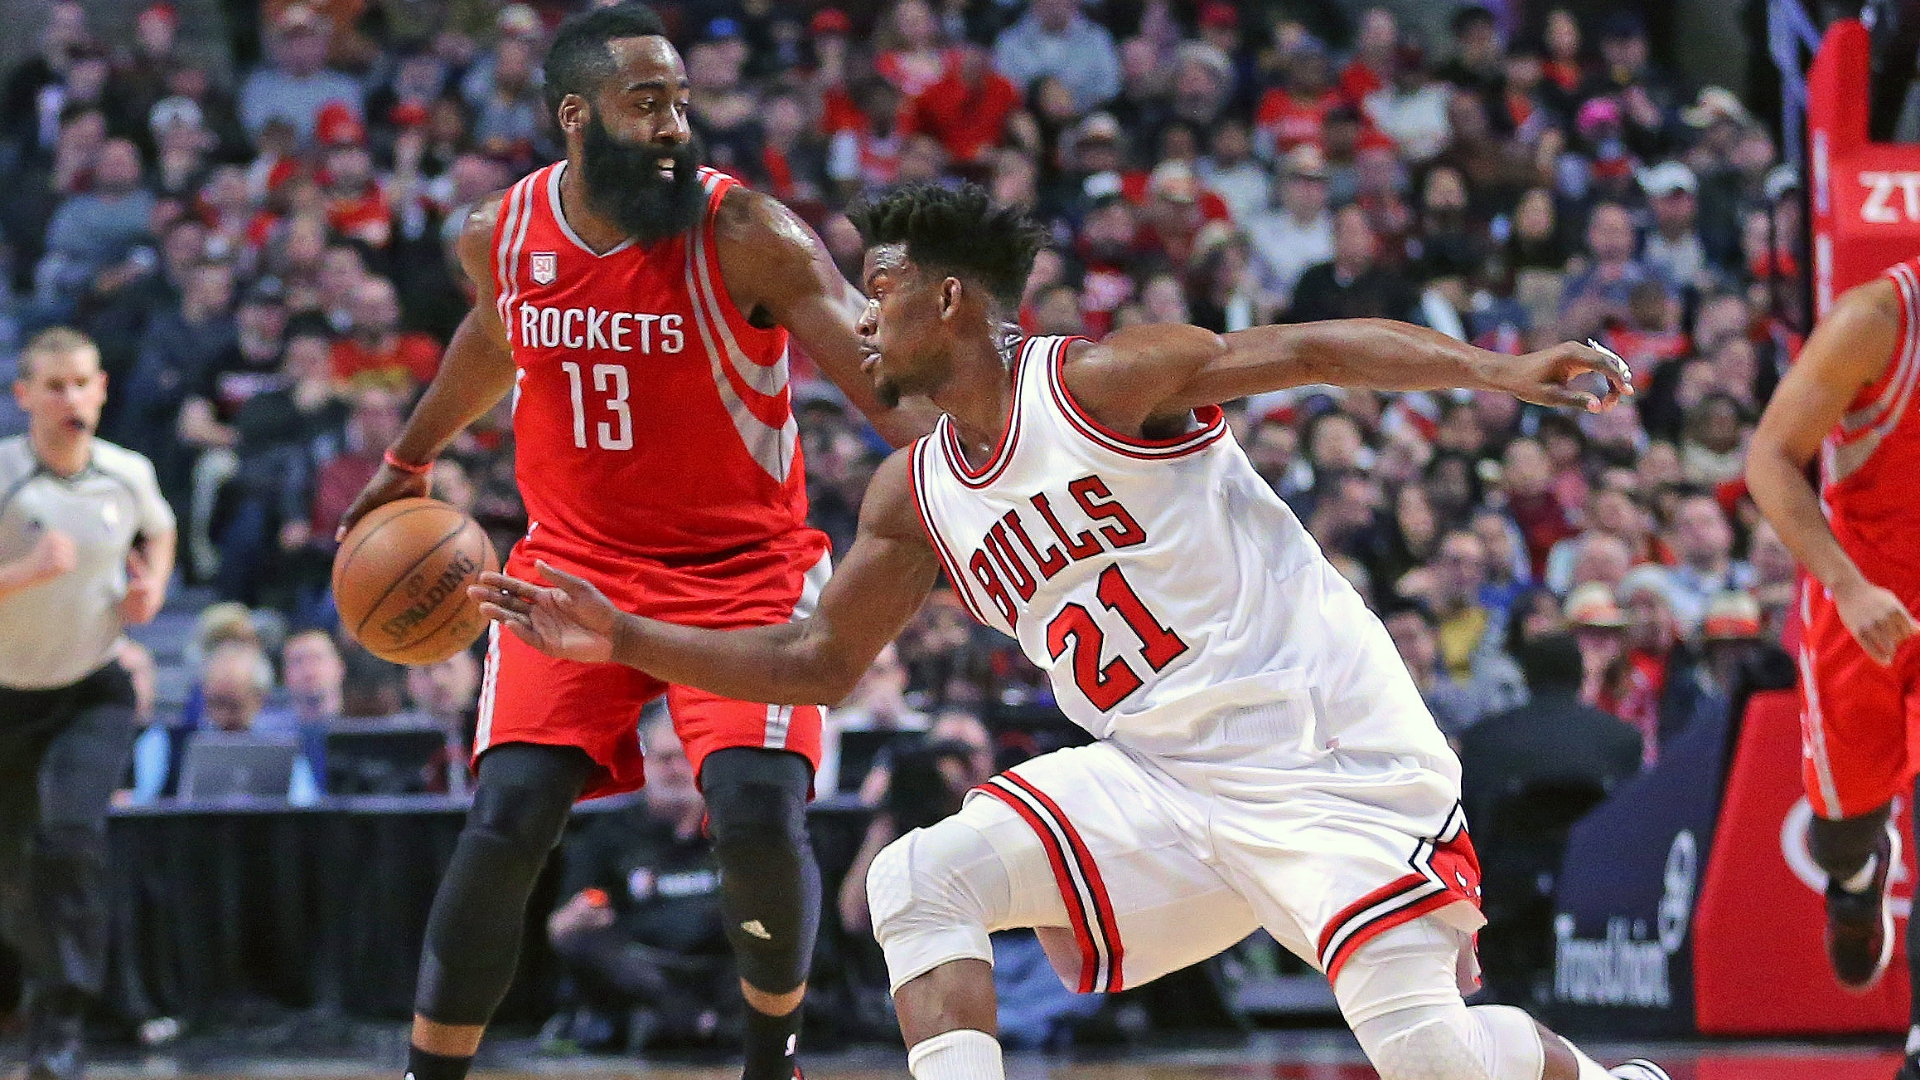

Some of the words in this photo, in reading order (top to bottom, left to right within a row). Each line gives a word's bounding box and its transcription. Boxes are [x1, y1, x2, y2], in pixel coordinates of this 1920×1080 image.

[519, 300, 685, 355] ROCKETS
[561, 361, 634, 450] 13
[380, 551, 476, 645] SPALDING
[969, 474, 1147, 634] BULLS
[1047, 562, 1190, 713] 21
